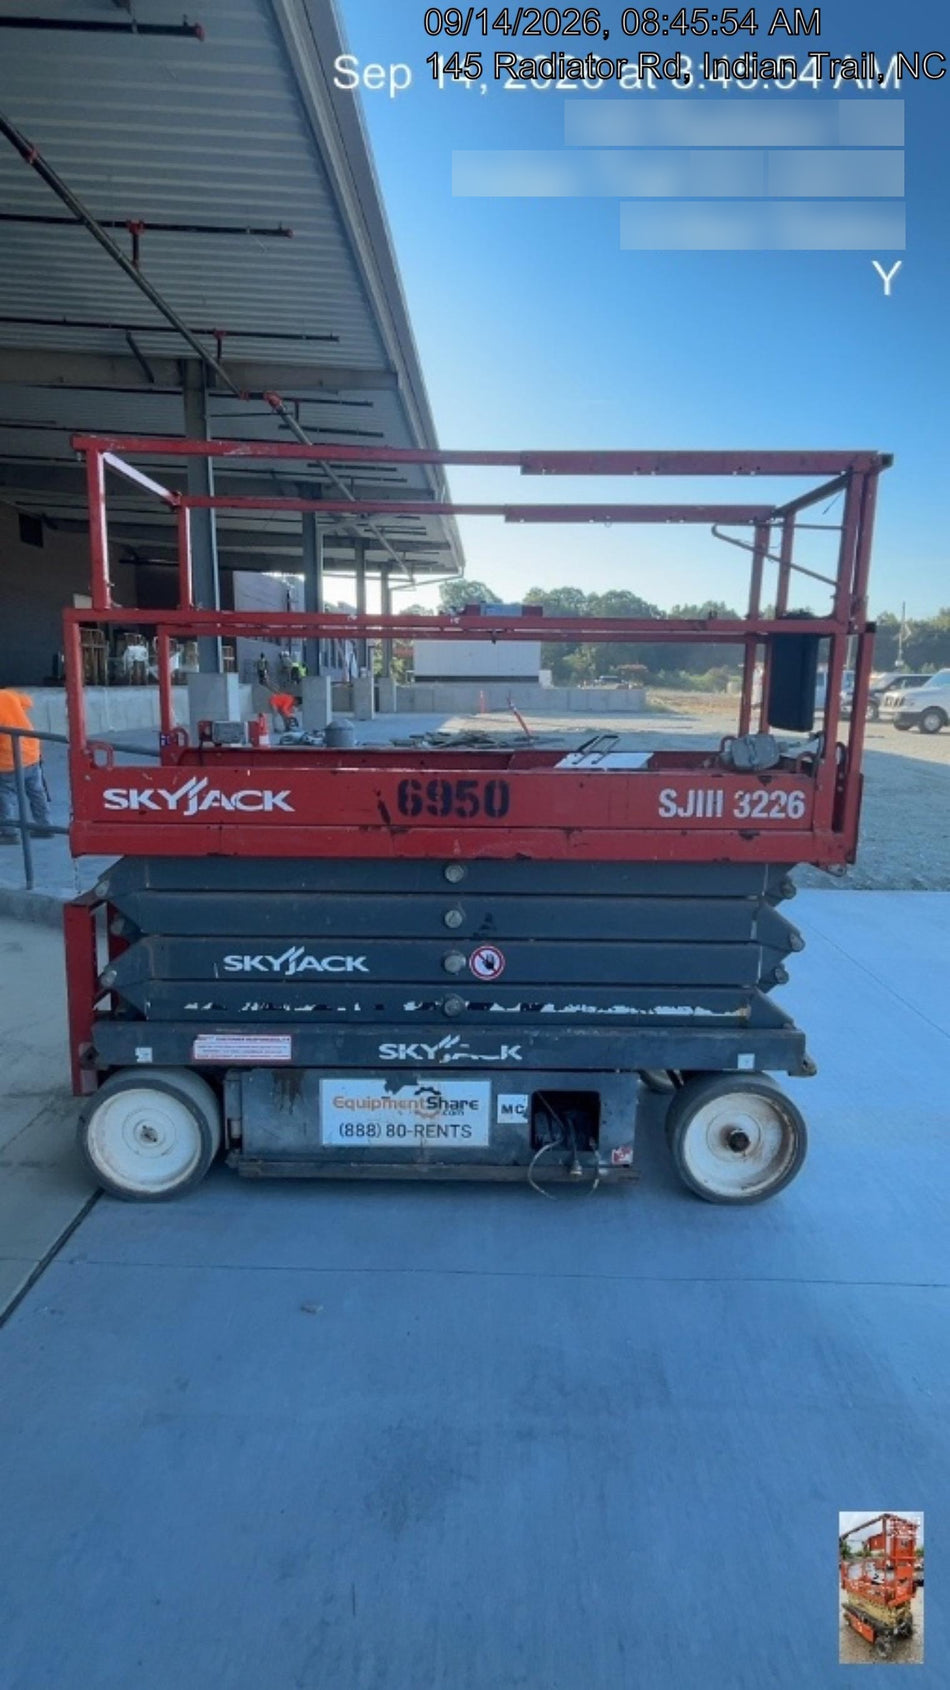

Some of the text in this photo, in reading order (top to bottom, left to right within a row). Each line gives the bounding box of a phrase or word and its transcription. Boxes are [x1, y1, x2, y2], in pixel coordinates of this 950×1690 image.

[103, 776, 295, 816] SKYJACK
[397, 779, 510, 818] 6950
[658, 788, 806, 819] SJIII 3226
[223, 946, 369, 976] SKYJACK
[339, 1122, 472, 1139] (888) 80-RENTS
